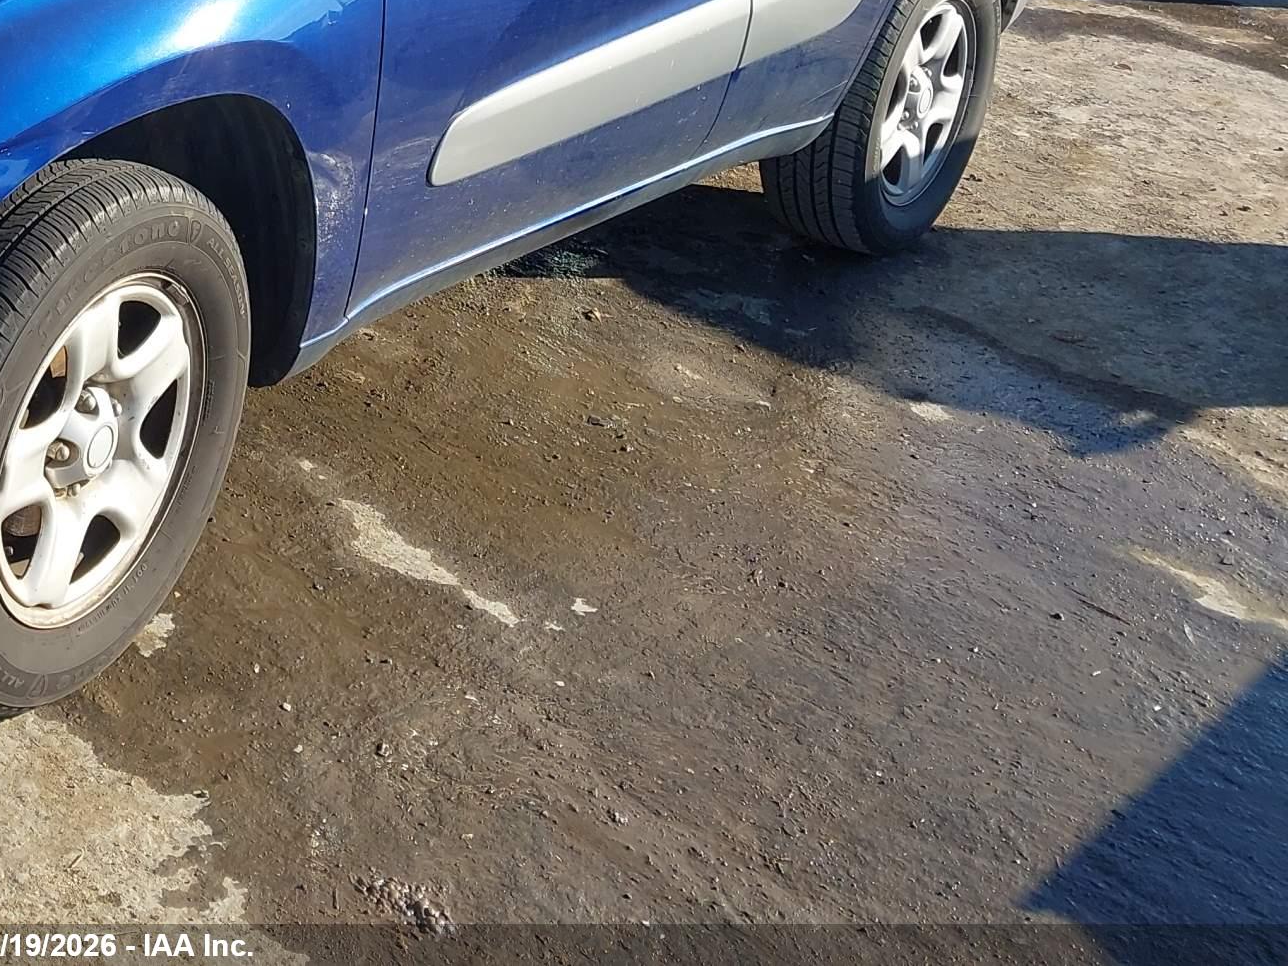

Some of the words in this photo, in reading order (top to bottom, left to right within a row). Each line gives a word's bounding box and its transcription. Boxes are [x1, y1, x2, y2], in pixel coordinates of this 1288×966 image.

[206, 237, 224, 259] ALL
[223, 256, 246, 318] SEASON
[1, 671, 25, 689] ALL
